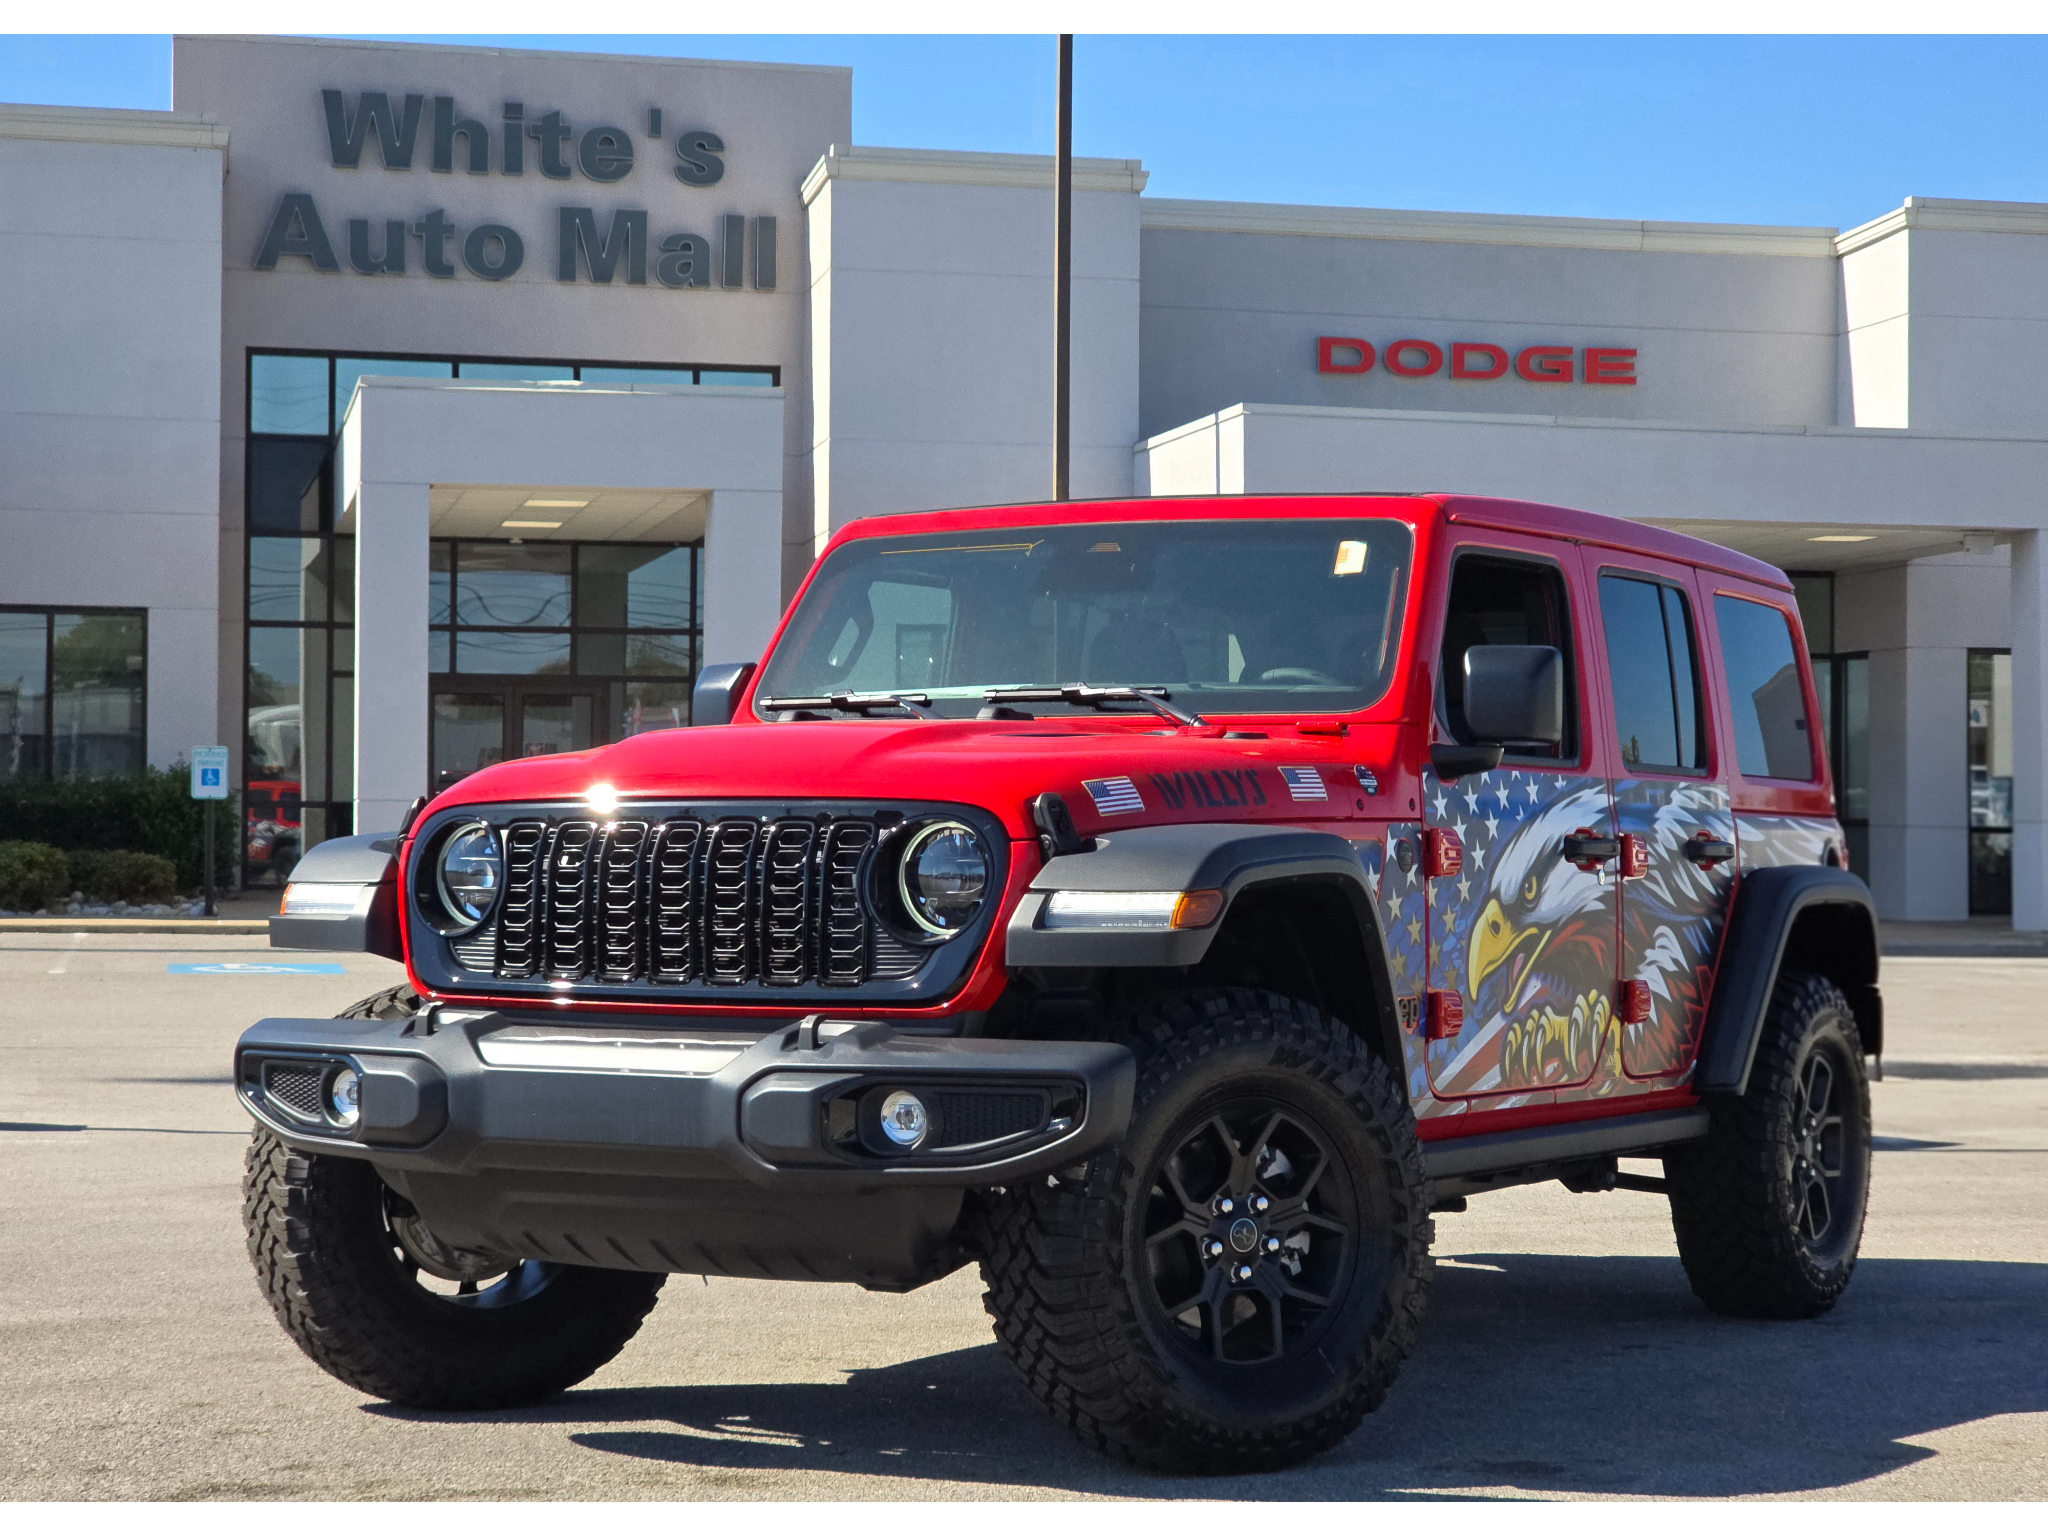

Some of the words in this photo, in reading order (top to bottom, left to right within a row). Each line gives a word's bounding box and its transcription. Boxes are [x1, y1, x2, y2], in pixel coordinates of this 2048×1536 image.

[321, 88, 726, 187] White's
[253, 192, 526, 280] Auto
[556, 205, 778, 291] Mall
[1317, 336, 1638, 385] DODGE
[1147, 768, 1267, 810] WILLYS
[1398, 997, 1420, 1029] ep
[1269, 1045, 1408, 1271] WILDPEAK
